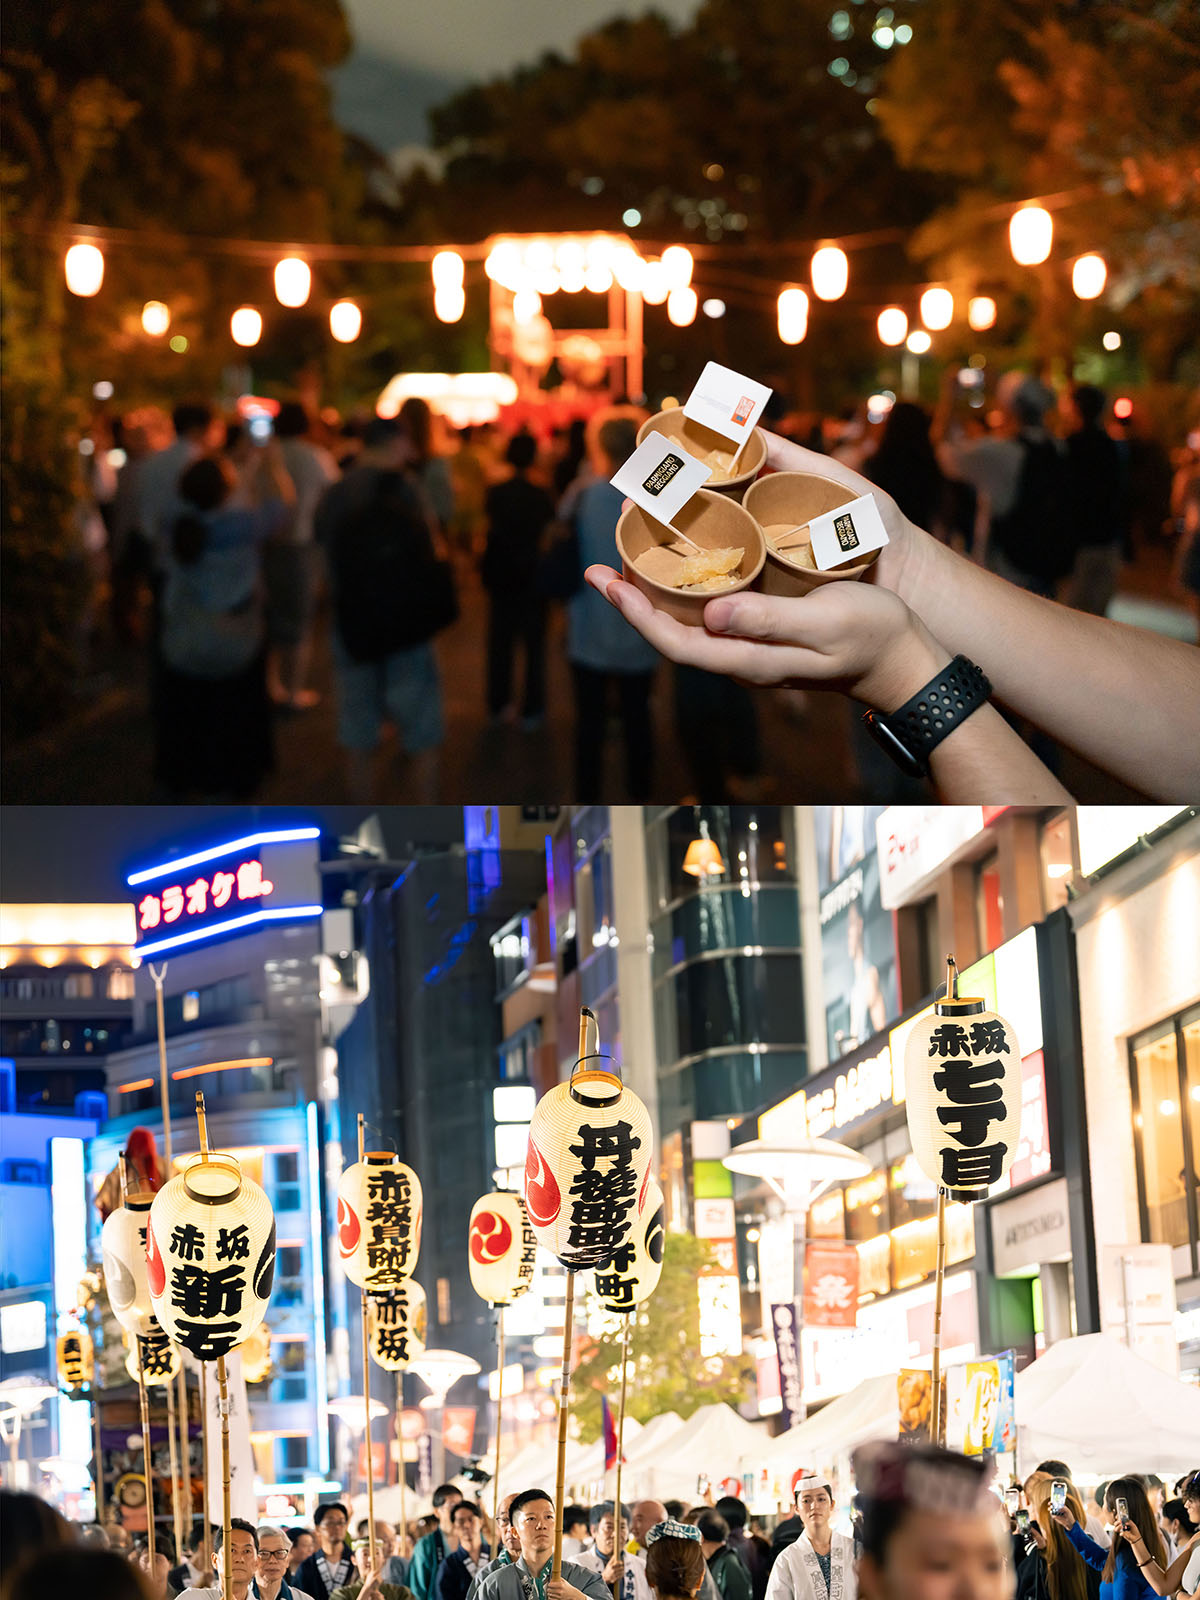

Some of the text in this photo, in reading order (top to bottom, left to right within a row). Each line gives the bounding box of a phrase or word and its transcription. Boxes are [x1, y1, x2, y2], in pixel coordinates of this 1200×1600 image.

[645, 456, 675, 489] PARMIGIANO
[654, 463, 679, 491] REGGIANO
[928, 1020, 1010, 1058] 赤坂
[933, 1059, 1008, 1187] 七丁目
[169, 1223, 250, 1262] 赤坂
